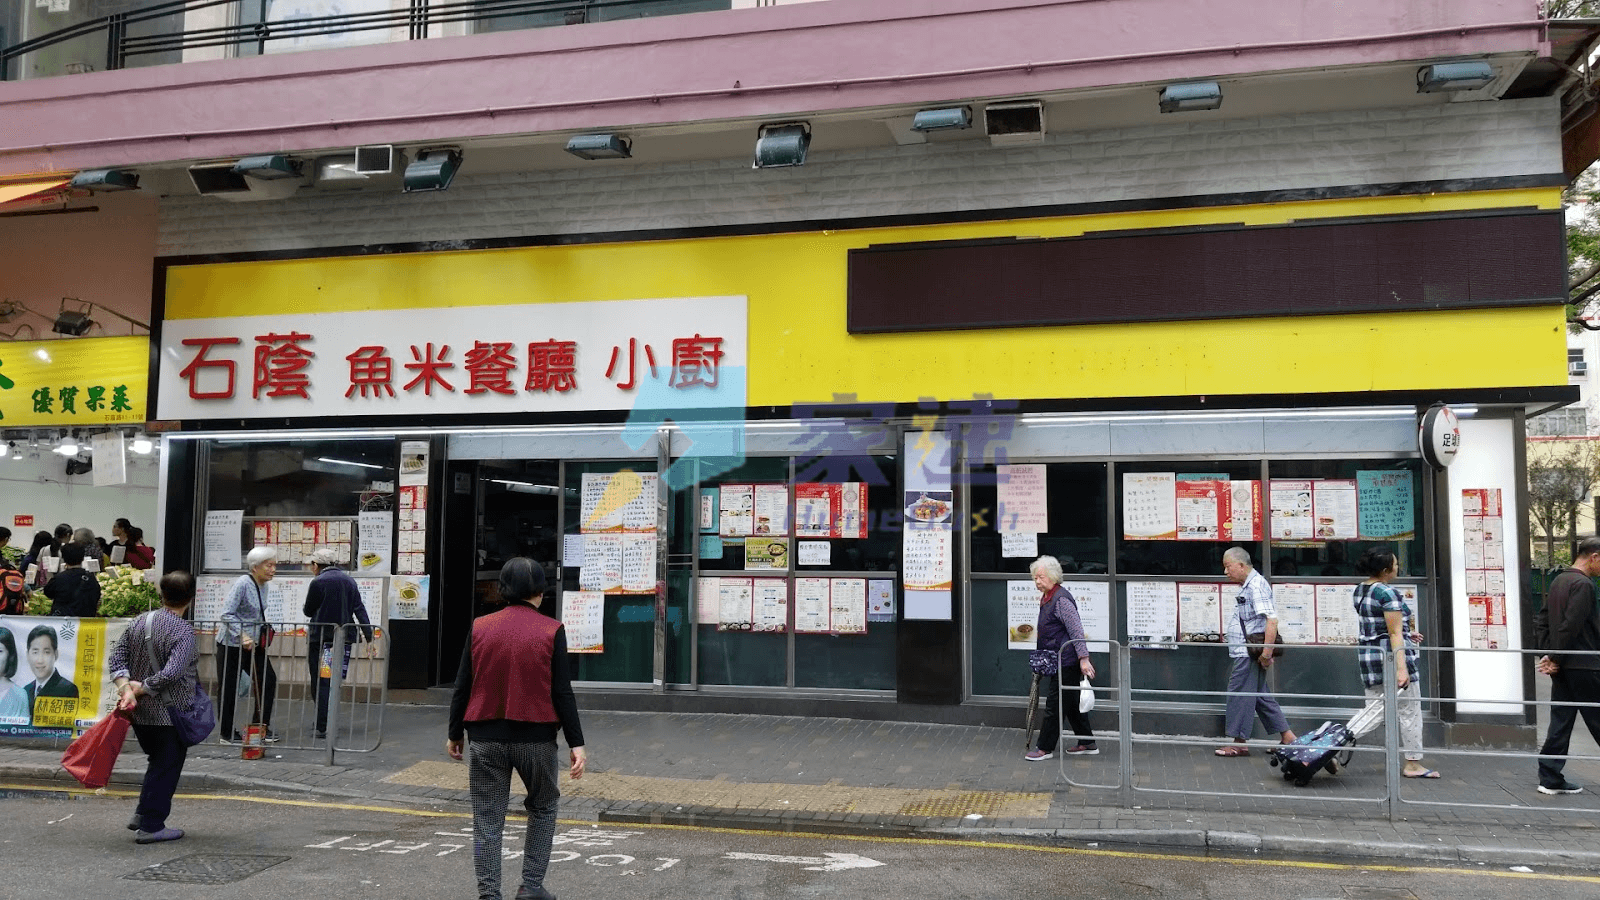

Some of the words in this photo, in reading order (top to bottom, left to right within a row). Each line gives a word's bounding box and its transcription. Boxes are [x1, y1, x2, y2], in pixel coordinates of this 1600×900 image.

[178, 330, 315, 400] 石蔭
[344, 338, 578, 399] 魚米餐廳
[605, 332, 727, 392] 小廚
[31, 384, 133, 415] 優質果菜
[35, 698, 75, 714] 林紹輝
[303, 834, 466, 857] LEFT
